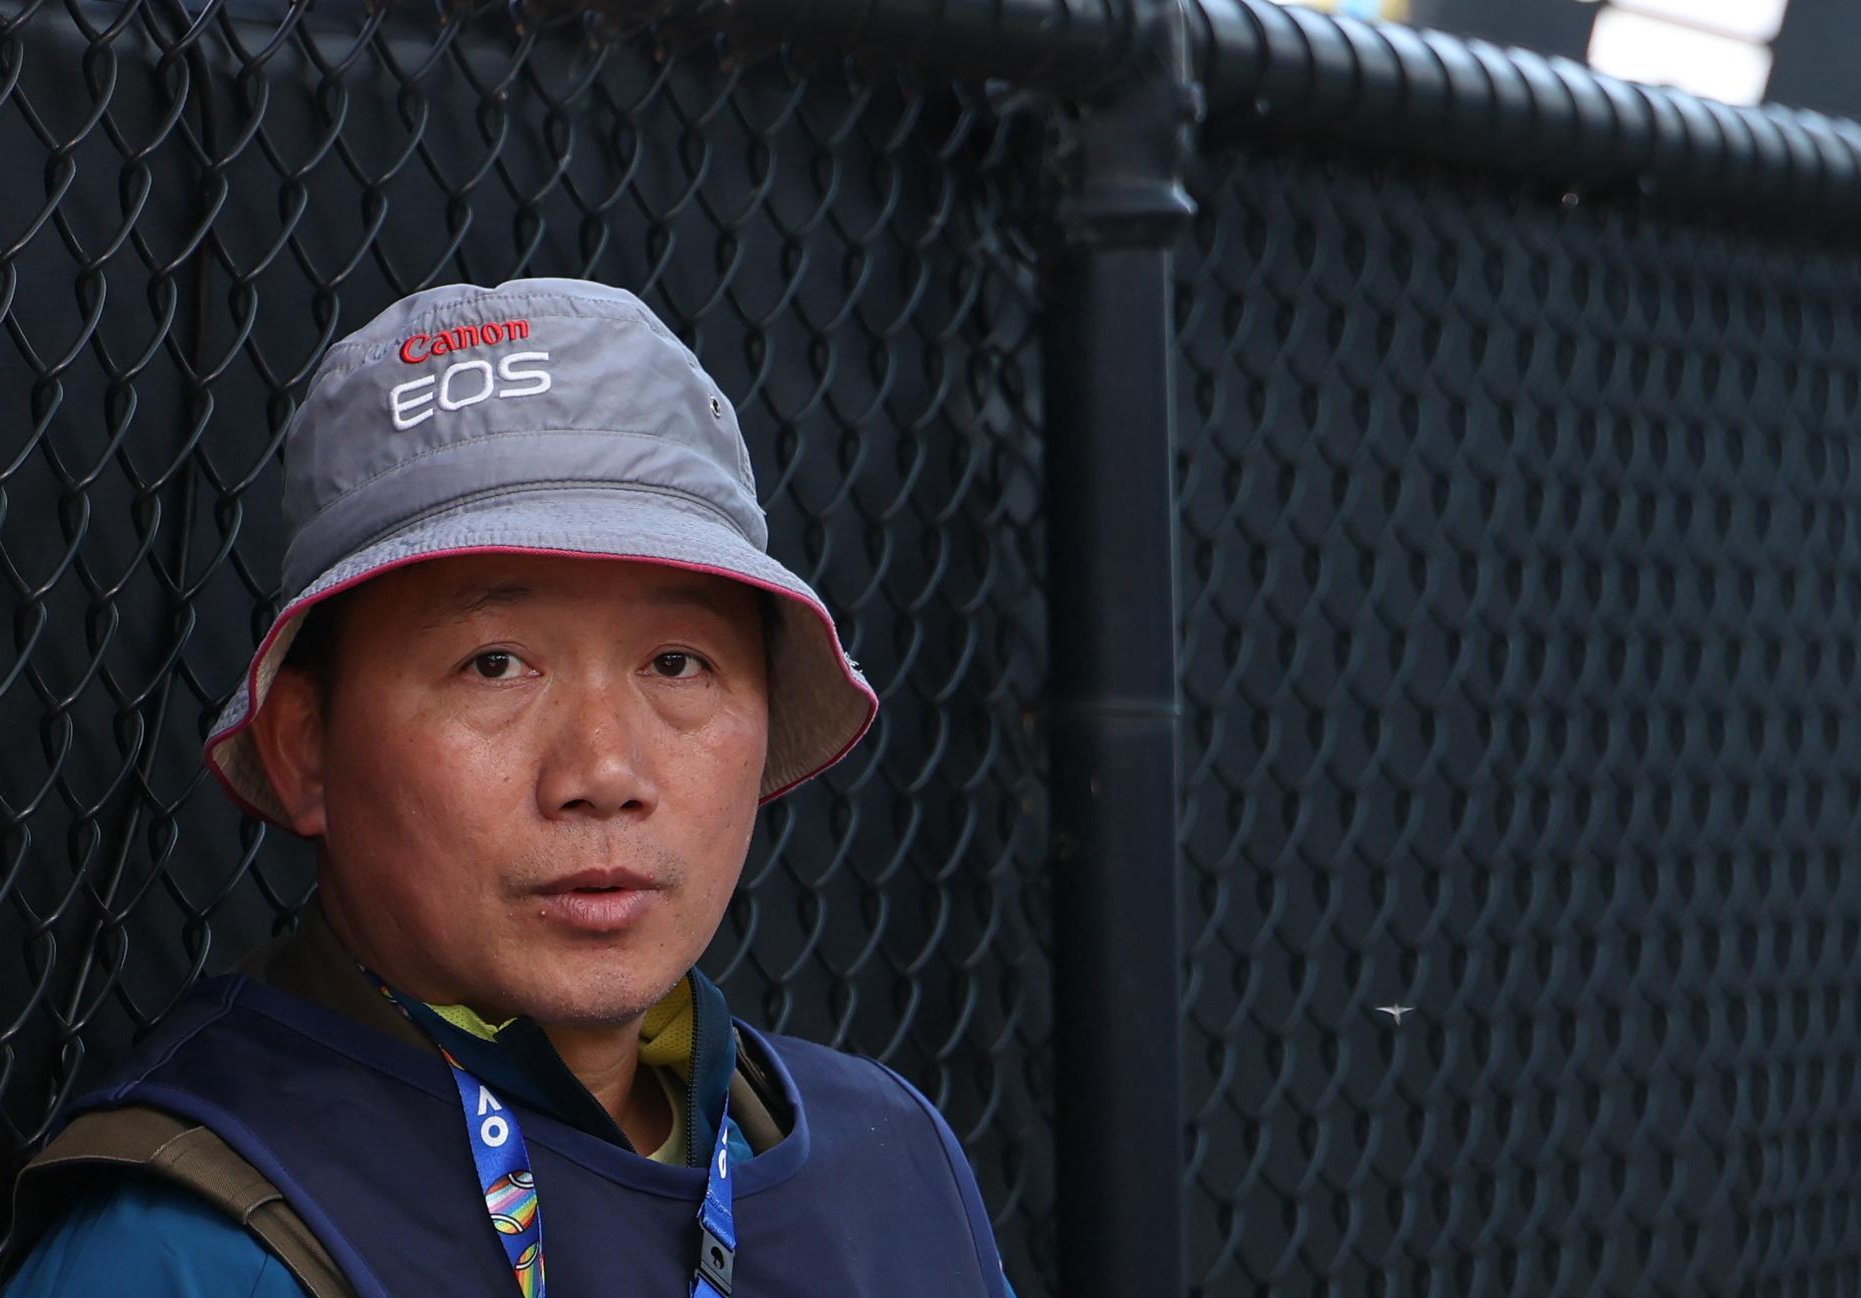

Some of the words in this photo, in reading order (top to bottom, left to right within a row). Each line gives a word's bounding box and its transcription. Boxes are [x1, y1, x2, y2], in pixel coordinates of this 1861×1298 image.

[399, 319, 529, 364] Canon
[389, 351, 551, 431] EOS
[477, 1084, 509, 1148] AO
